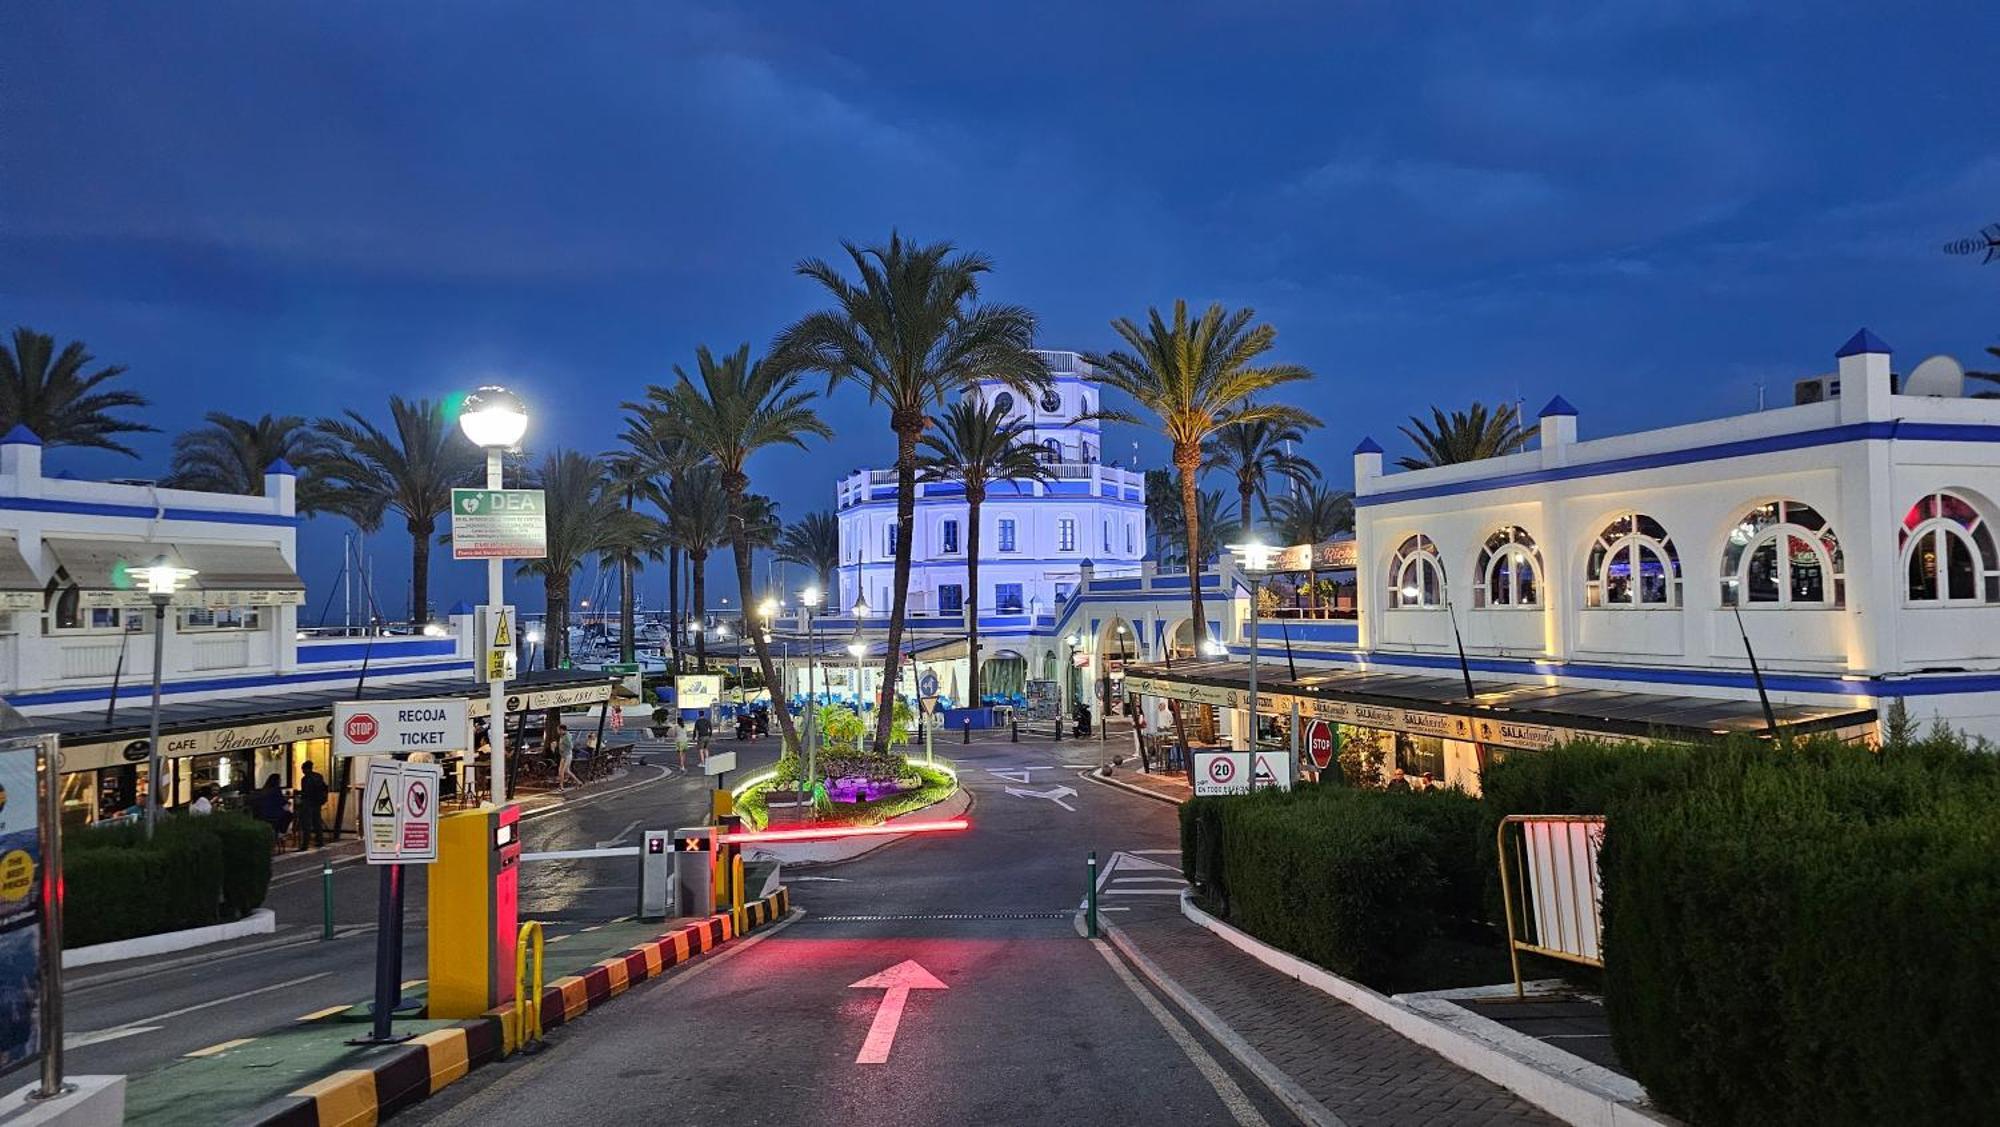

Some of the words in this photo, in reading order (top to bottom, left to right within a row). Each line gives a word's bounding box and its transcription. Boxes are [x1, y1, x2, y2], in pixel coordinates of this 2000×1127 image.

[490, 493, 535, 511] DEA
[398, 709, 447, 722] RECOJA
[349, 722, 373, 736] STOP
[168, 739, 196, 752] CAFE
[213, 728, 281, 750] Reinaldo
[296, 724, 315, 735] BAR
[400, 731, 445, 745] TICKET
[1312, 738, 1330, 750] STOP
[1214, 764, 1230, 776] 20
